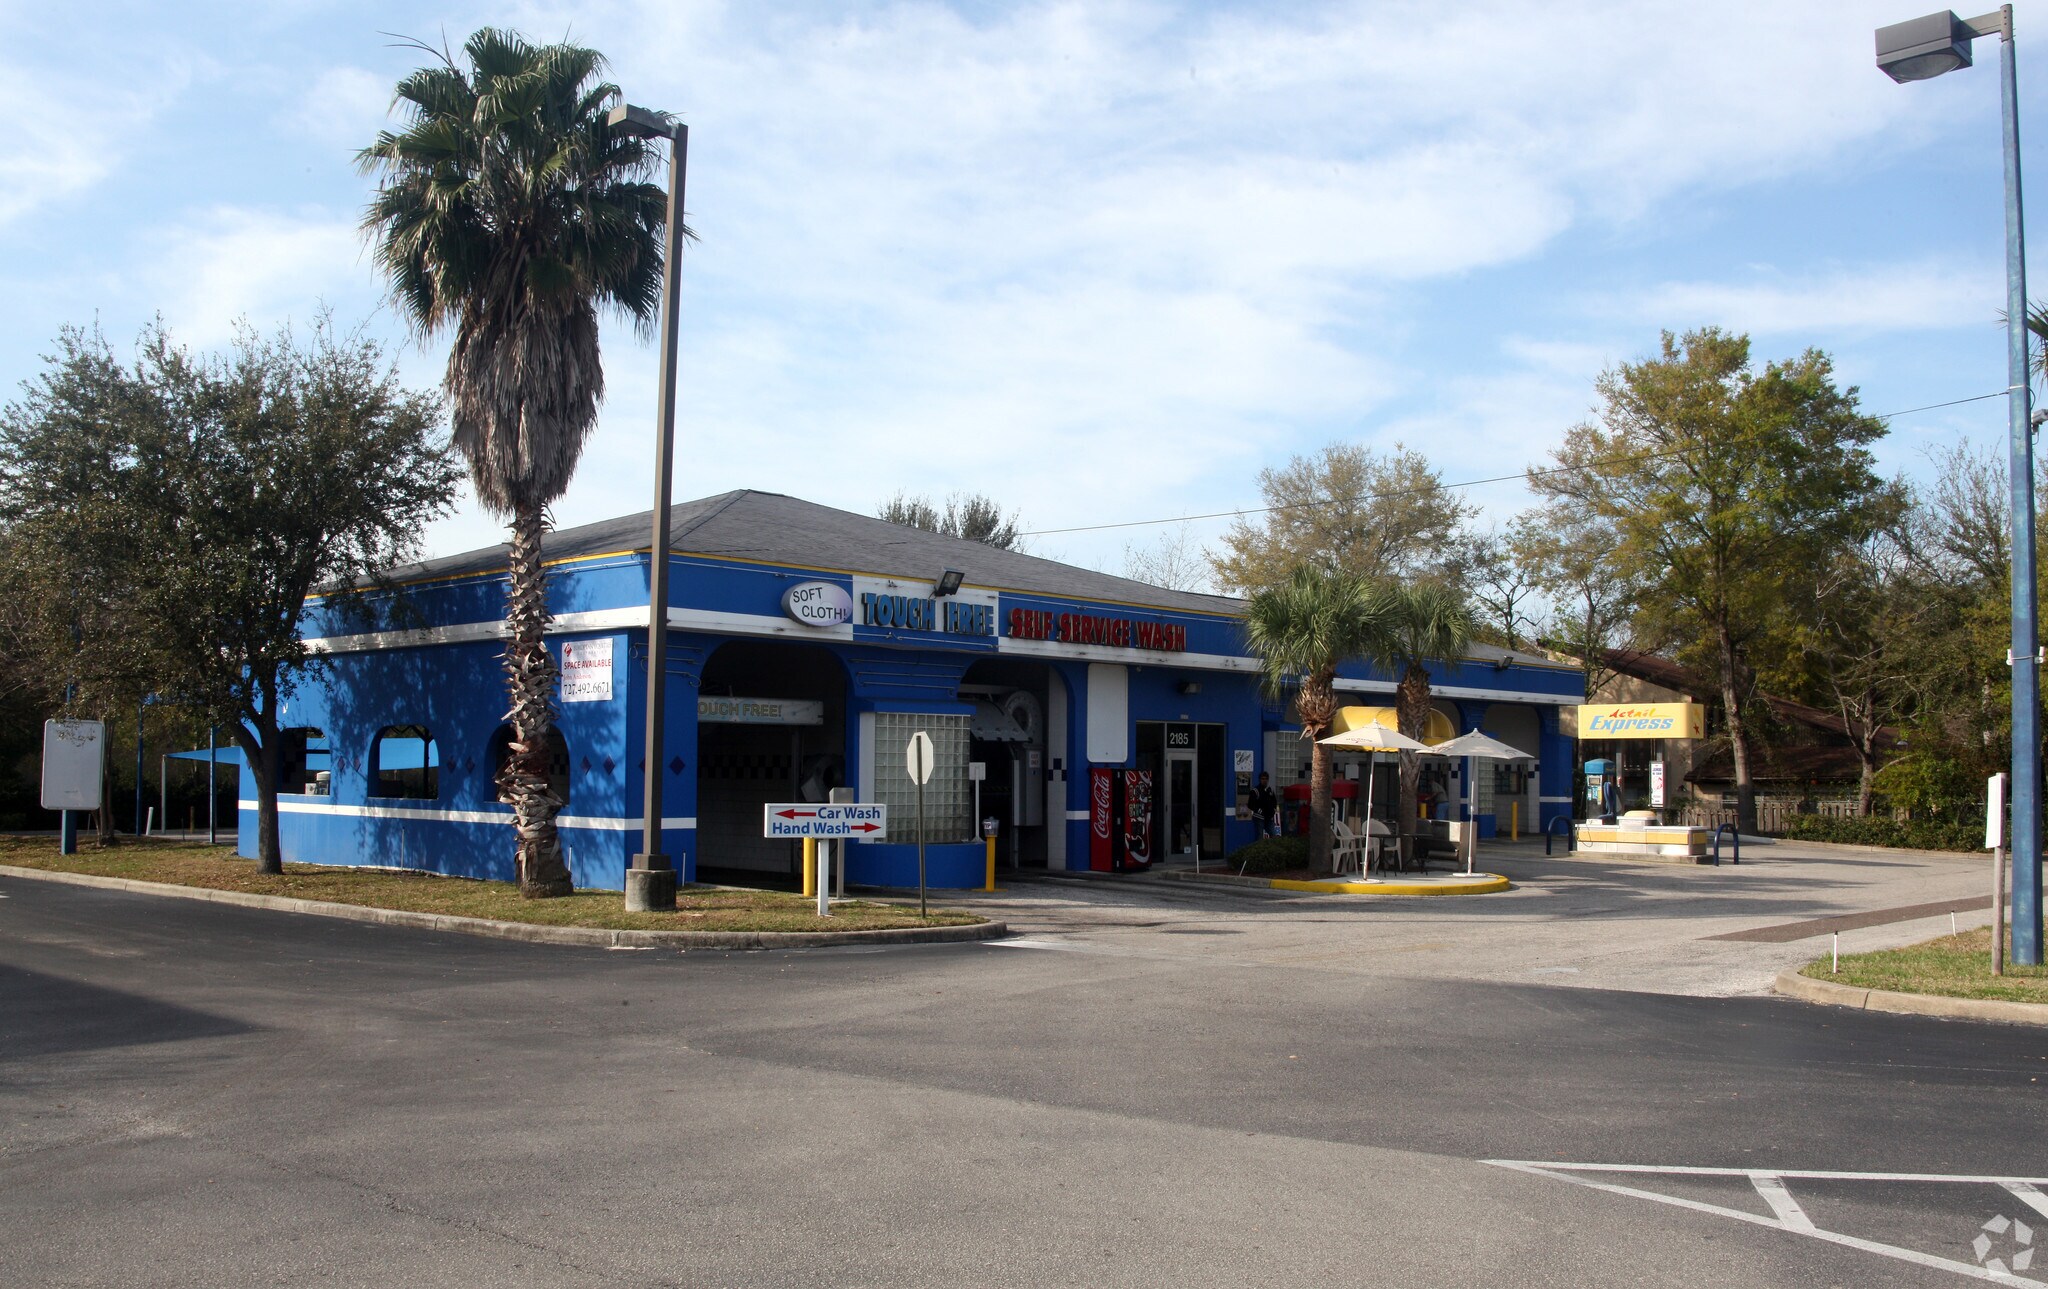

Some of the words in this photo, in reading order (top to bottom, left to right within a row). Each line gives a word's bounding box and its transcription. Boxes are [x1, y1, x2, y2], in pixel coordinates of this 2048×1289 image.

[793, 587, 823, 603] SOFT
[802, 605, 847, 620] CLOTH!
[861, 592, 936, 631] TOUCH
[943, 601, 994, 636] FREE
[1008, 607, 1054, 640] SELF
[1056, 613, 1131, 648] SERVICE
[1135, 621, 1187, 652] WASH
[564, 660, 581, 670] SPACE
[581, 658, 611, 669] AVAILABLE
[564, 681, 610, 696] 727.492.6671
[698, 702, 739, 716] OUCH
[743, 703, 783, 717] FREE!
[1589, 715, 1675, 734] Express
[1170, 732, 1189, 745] 2185
[817, 807, 841, 819] Car
[843, 807, 880, 819] Wash
[772, 822, 810, 834] Hand
[814, 822, 850, 834] Wash
